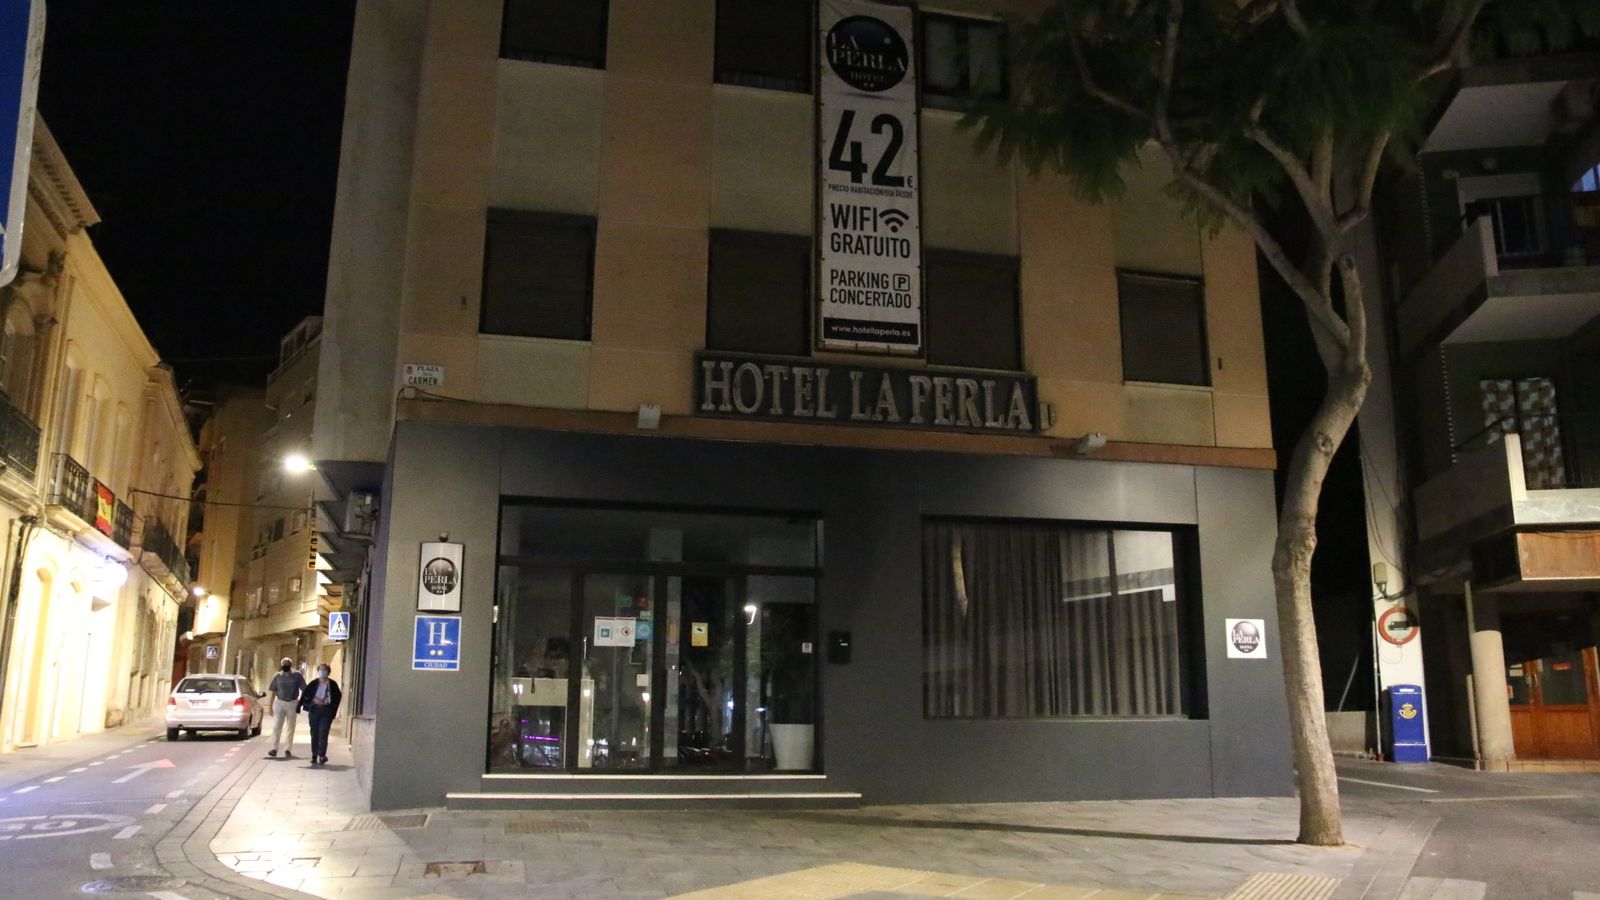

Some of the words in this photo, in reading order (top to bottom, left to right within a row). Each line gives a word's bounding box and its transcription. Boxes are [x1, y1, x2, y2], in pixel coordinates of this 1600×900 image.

[831, 32, 859, 50] LA
[832, 48, 906, 72] PERLA
[830, 203, 878, 232] WIFI
[830, 232, 911, 259] GRATUITO
[830, 269, 889, 290] PARKING
[830, 288, 912, 309] CONCERTADO
[831, 326, 911, 337] www.hotellaperla.es
[408, 376, 438, 386] CARMEN
[701, 360, 838, 419] HOTEL
[850, 371, 901, 422] LA
[909, 374, 1033, 431] PERLA
[424, 567, 437, 575] LA
[424, 575, 457, 585] PERLA
